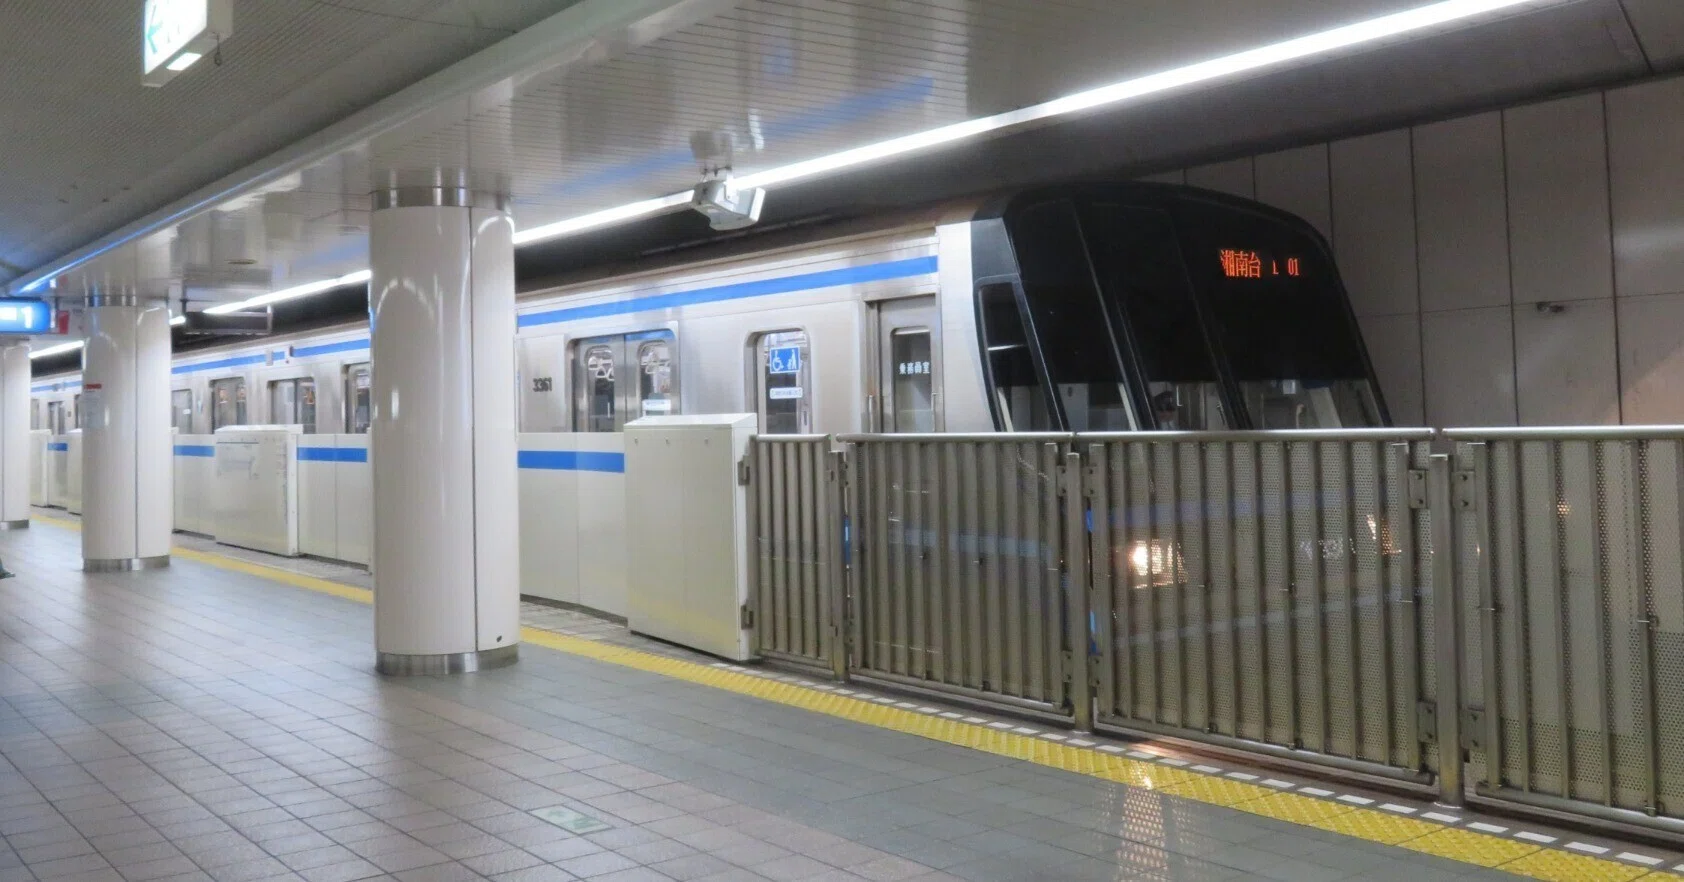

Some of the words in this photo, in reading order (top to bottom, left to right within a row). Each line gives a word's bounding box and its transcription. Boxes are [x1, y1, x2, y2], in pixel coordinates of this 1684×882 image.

[1220, 249, 1260, 278] 湘南台
[21, 306, 33, 329] 1
[899, 361, 930, 375] 乗務員室
[532, 377, 553, 393] 3361
